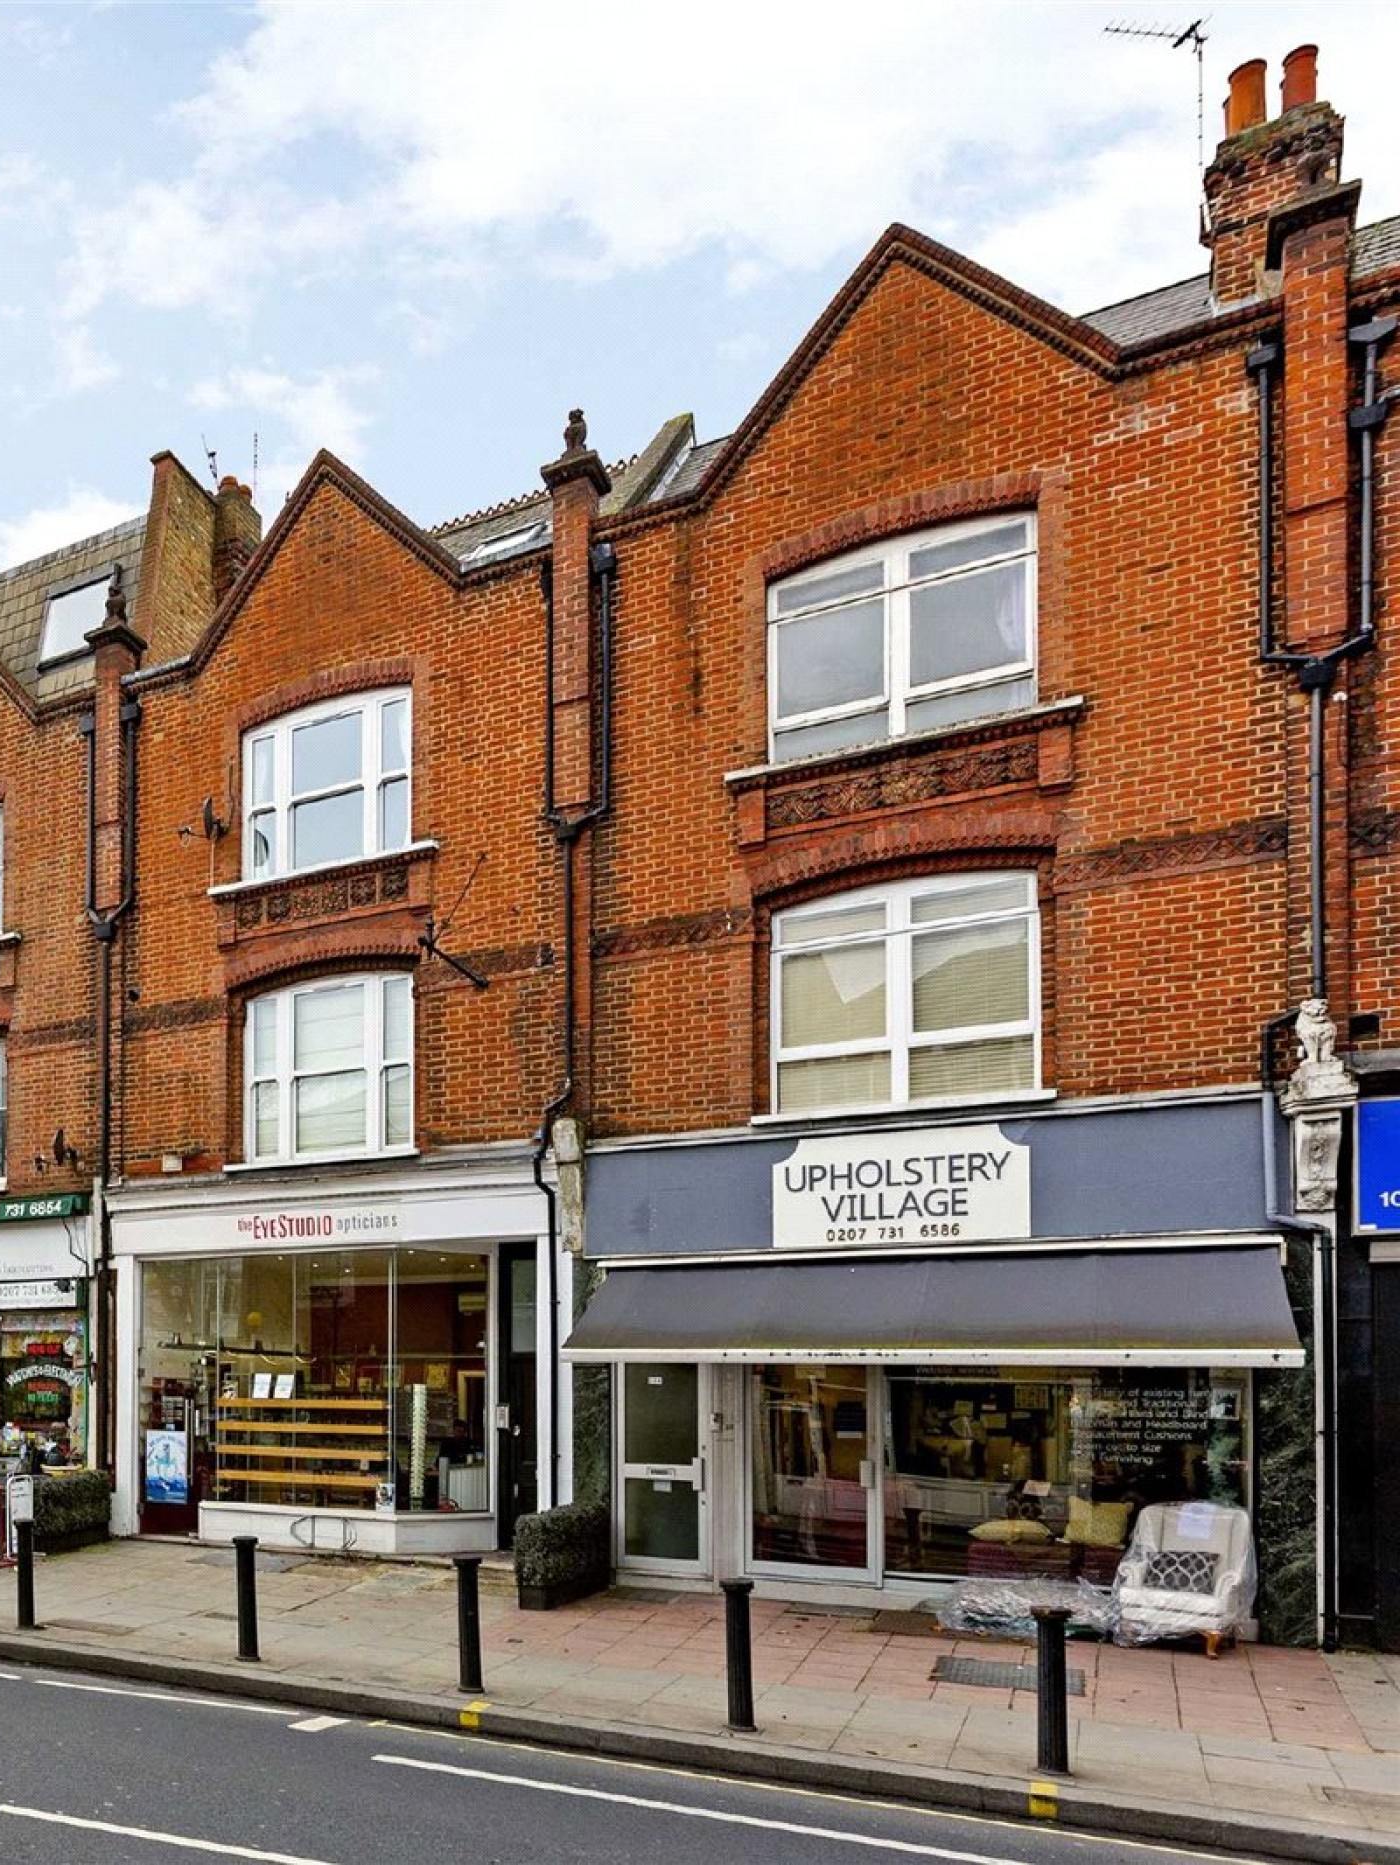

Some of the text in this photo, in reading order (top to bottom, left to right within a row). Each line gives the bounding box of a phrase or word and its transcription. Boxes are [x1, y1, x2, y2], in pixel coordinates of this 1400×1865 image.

[784, 1151, 1011, 1193] UPHOLSTERY
[4, 1203, 26, 1217] 731
[821, 1188, 969, 1223] VILLAGE
[337, 1212, 398, 1234] opticians
[826, 1223, 960, 1242] 0207 731 6586
